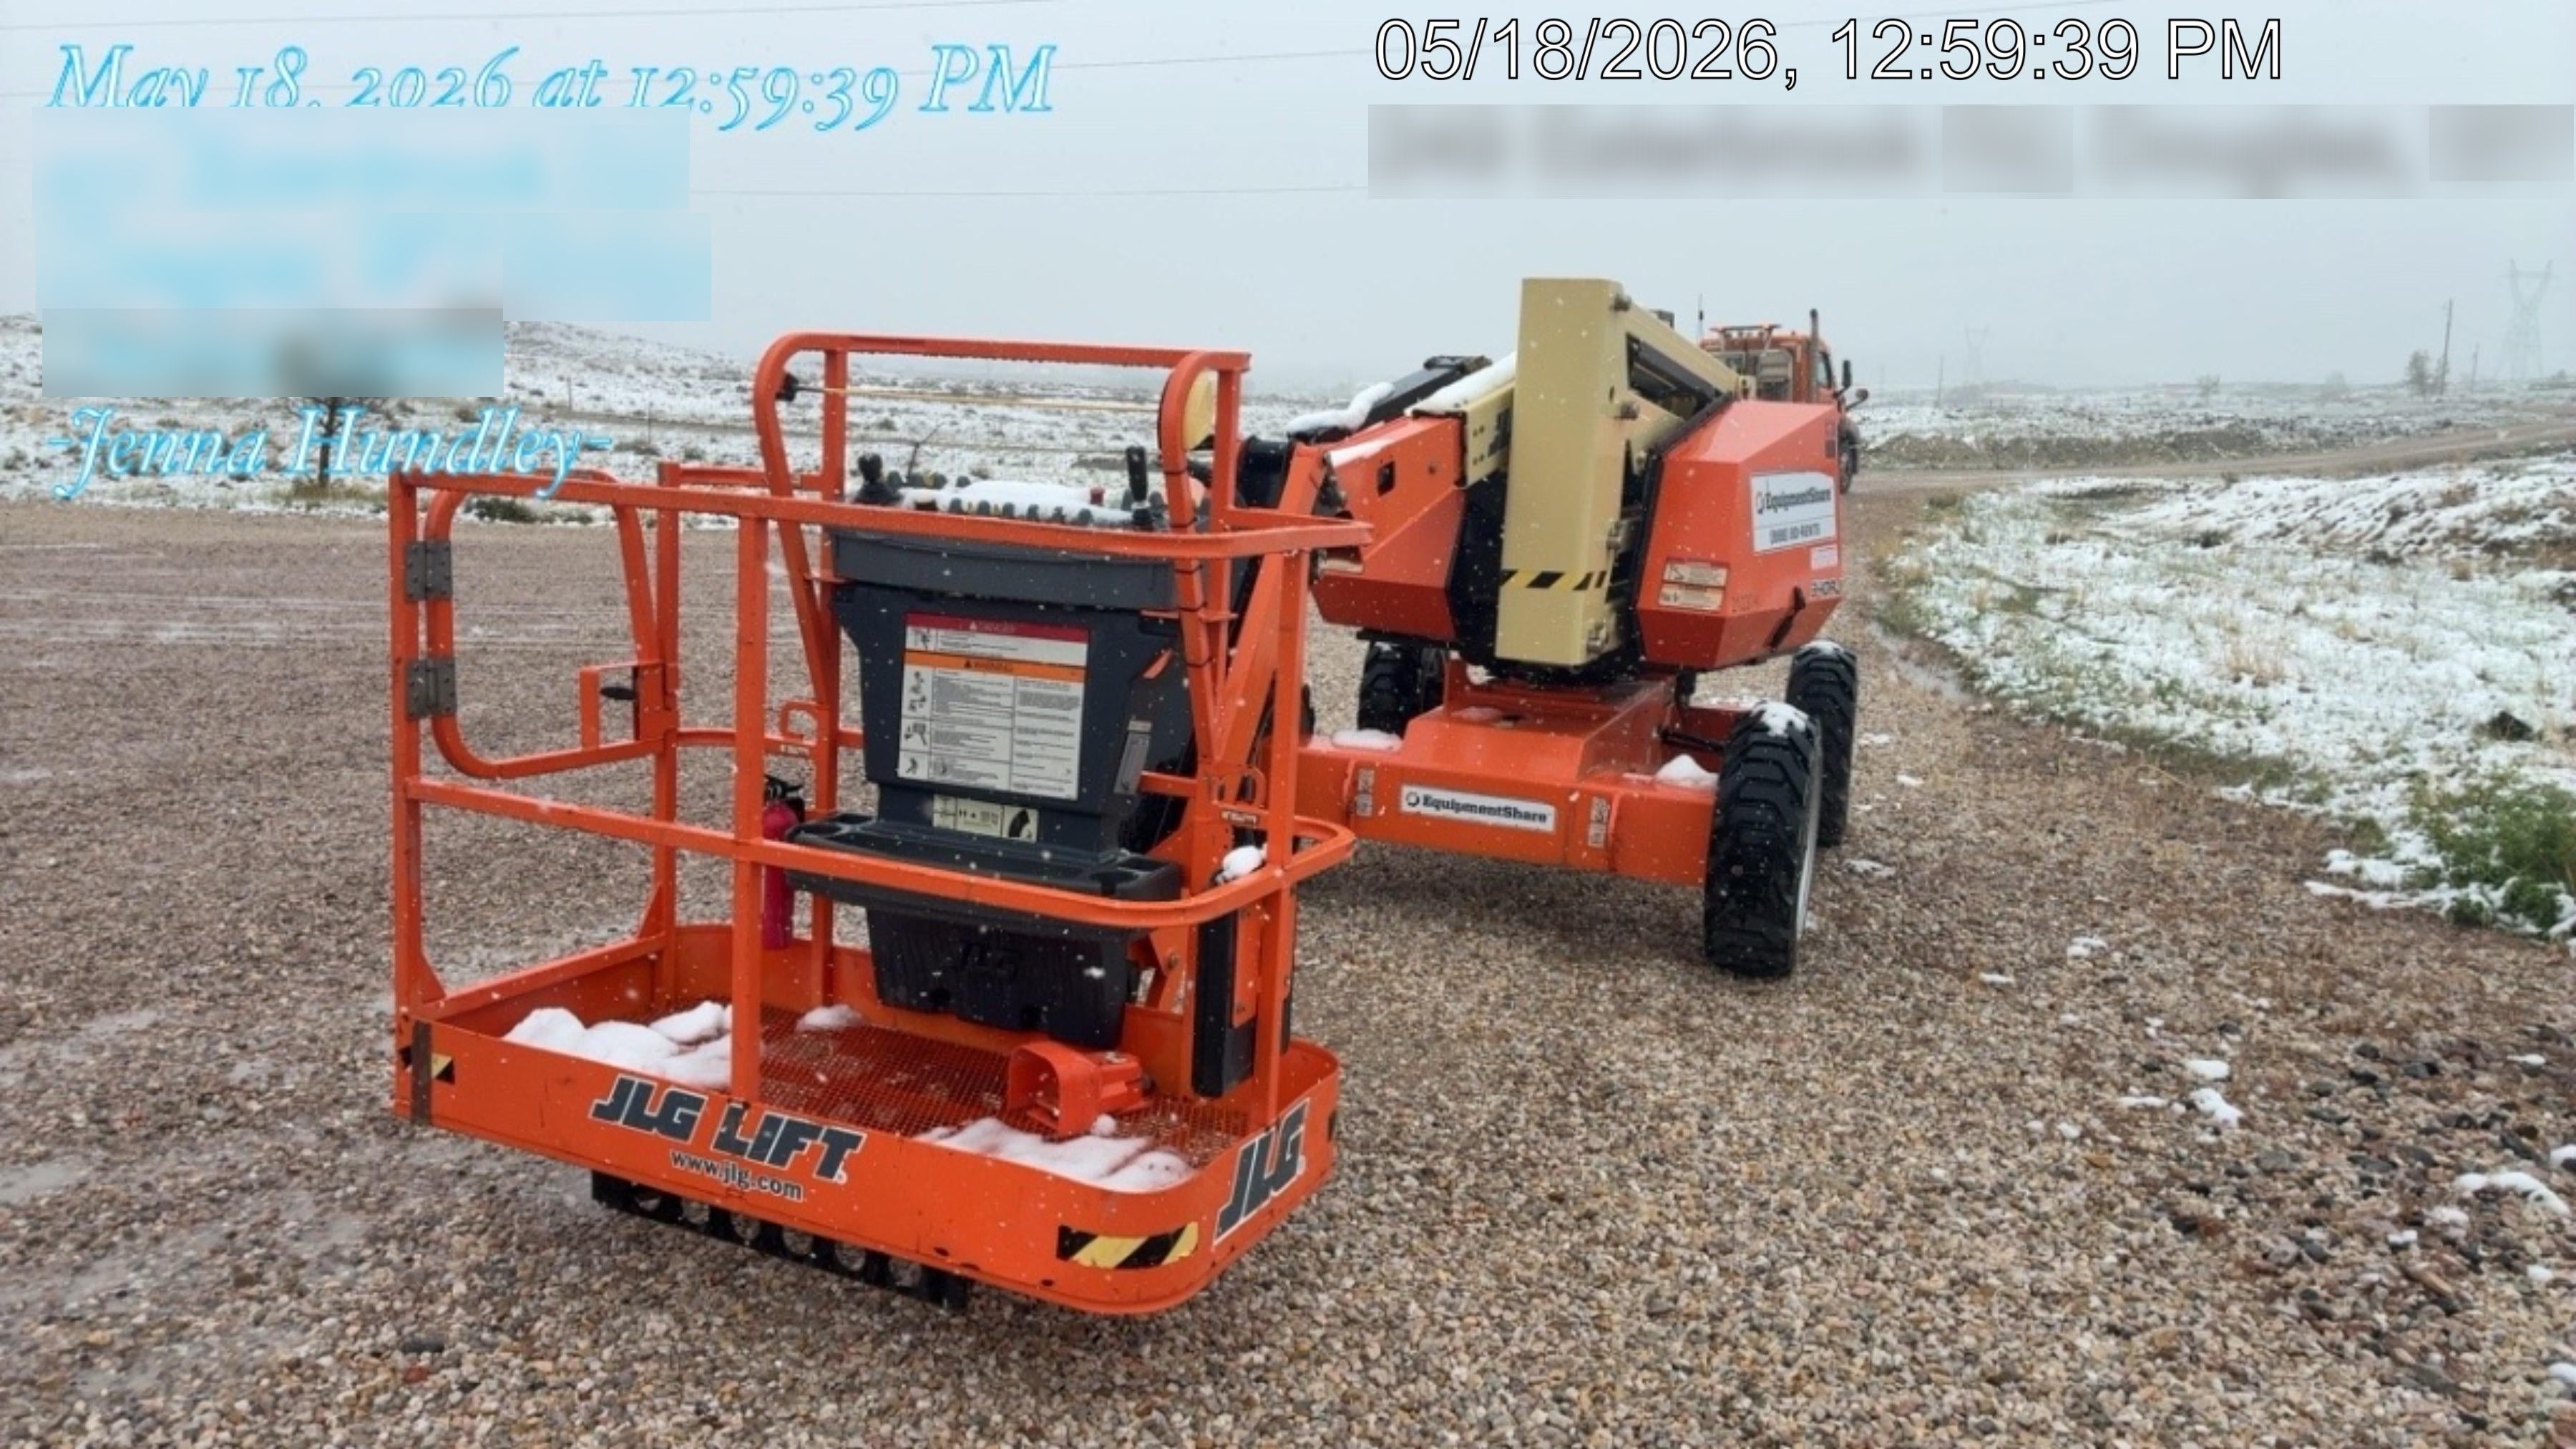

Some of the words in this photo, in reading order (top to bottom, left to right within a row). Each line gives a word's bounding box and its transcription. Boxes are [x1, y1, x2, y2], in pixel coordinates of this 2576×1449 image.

[1422, 792, 1548, 824] EquipmentShare
[589, 1073, 708, 1144] JLG
[711, 1102, 867, 1182] LIFT
[670, 1148, 804, 1202] www.jlg.com
[1214, 1098, 1311, 1247] JLG
